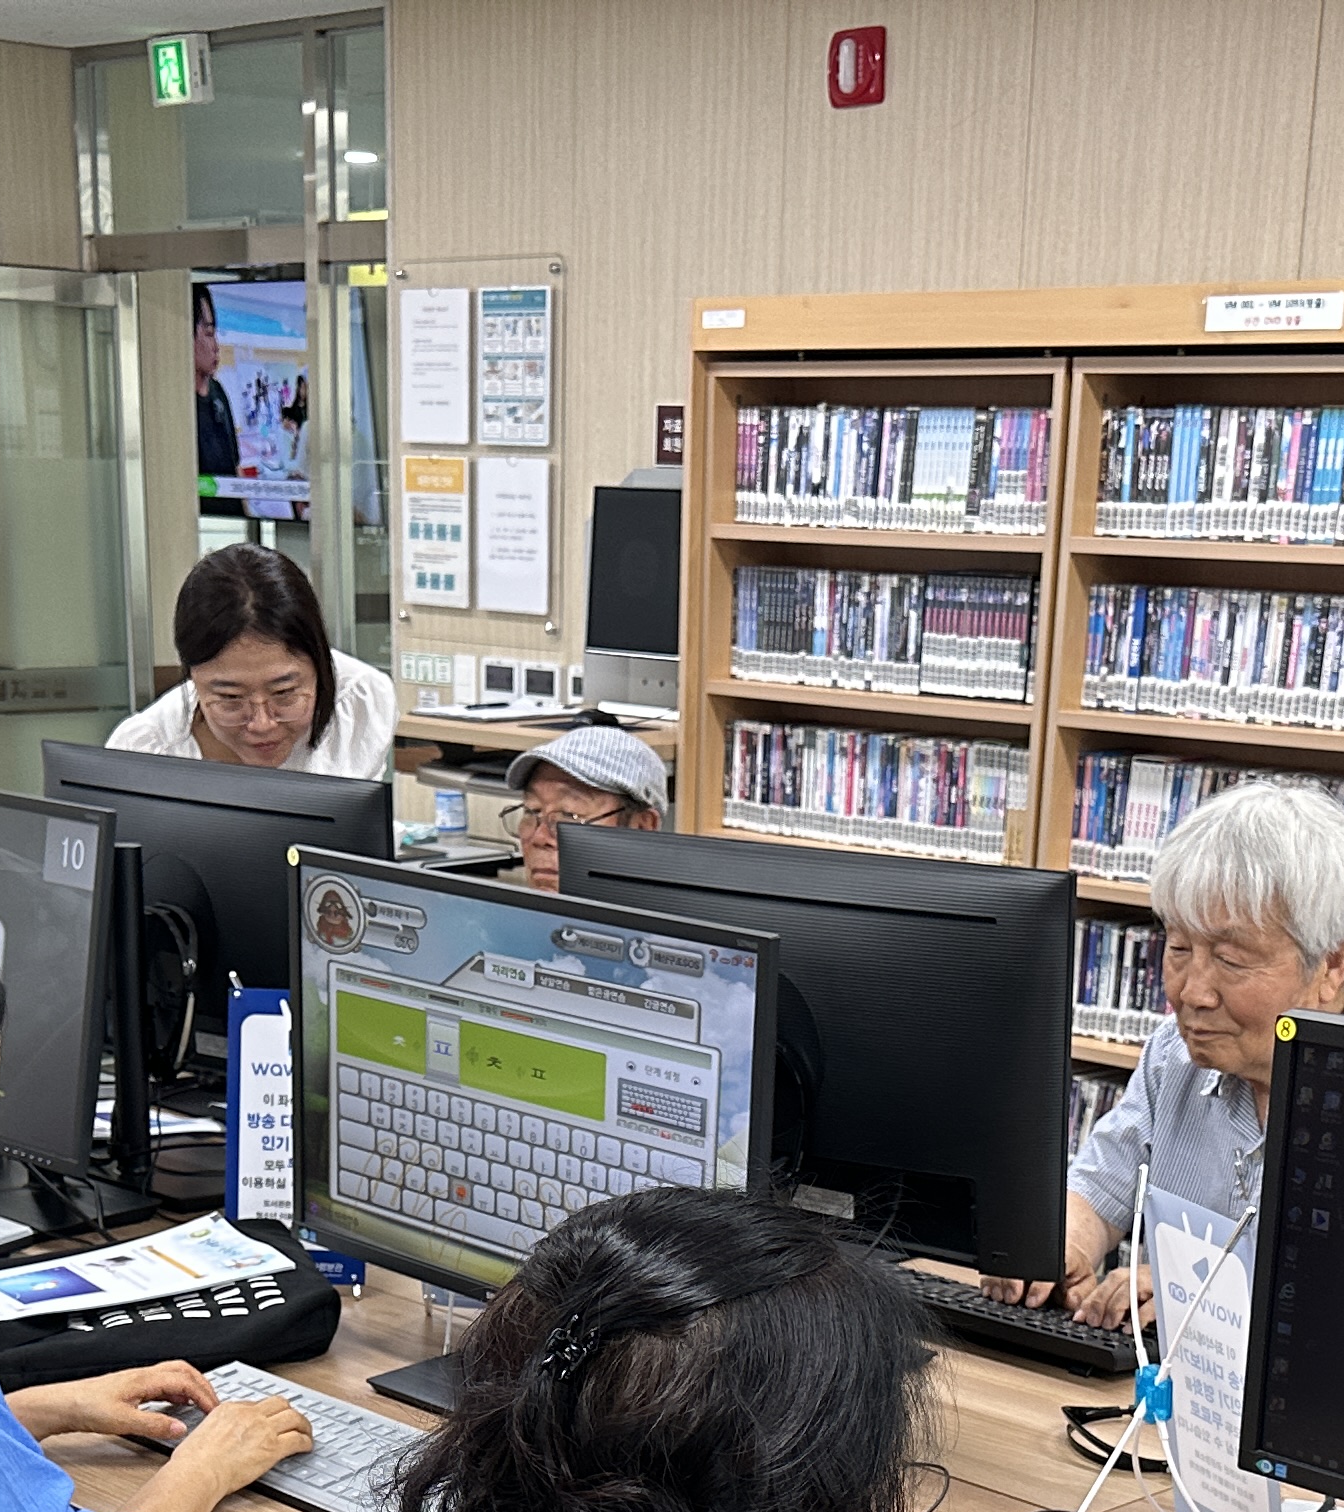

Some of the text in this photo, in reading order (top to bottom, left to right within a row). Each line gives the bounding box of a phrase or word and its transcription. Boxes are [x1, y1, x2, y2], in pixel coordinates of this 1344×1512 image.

[61, 837, 85, 871] 10
[491, 963, 526, 982] 자리연습
[1280, 1020, 1291, 1038] 8
[263, 1093, 274, 1106] 이
[247, 1112, 276, 1129] 방송
[262, 1135, 289, 1152] 인기
[264, 1160, 285, 1172] 모두
[241, 1176, 287, 1189] 이용하실
